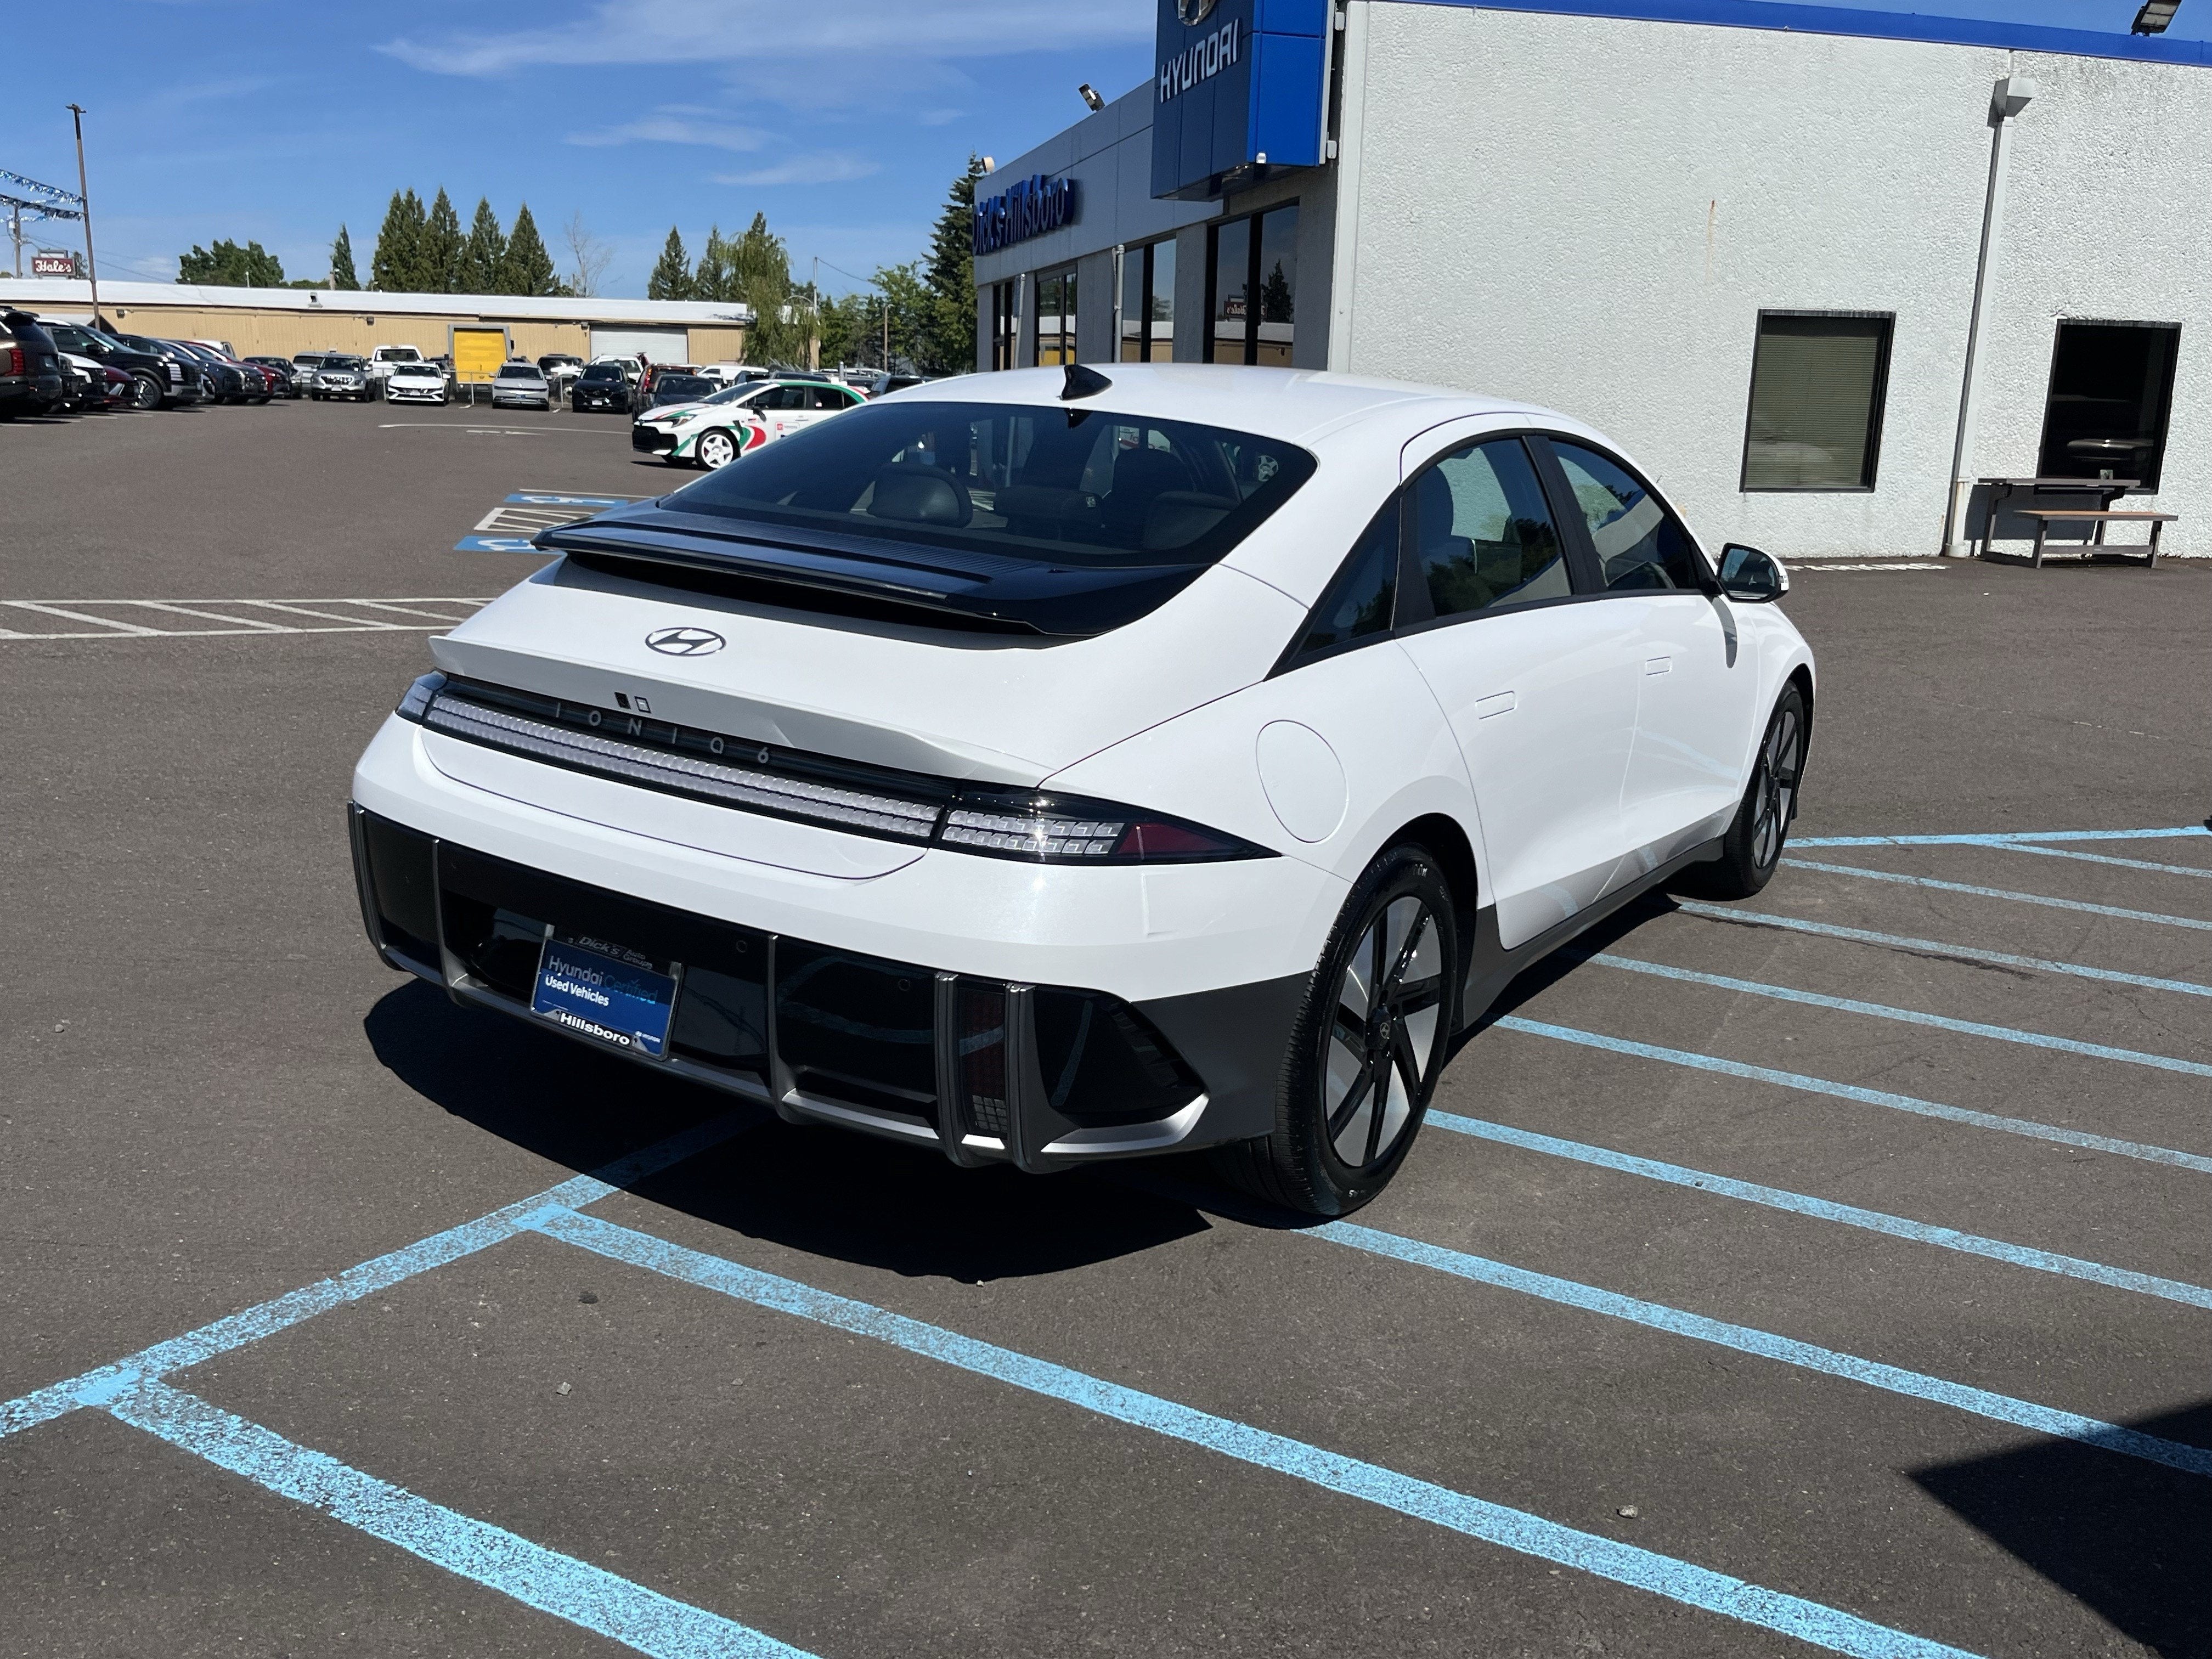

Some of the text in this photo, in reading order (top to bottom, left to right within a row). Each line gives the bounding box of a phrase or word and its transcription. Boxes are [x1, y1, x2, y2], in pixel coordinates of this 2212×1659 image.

[1160, 18, 1239, 104] HYUNDAI
[1005, 175, 1069, 245] Hillsboro
[35, 260, 72, 273] Hale's
[556, 702, 769, 764] IONIQ 6
[578, 936, 620, 955] Dick's
[549, 956, 603, 986] Hyundai
[545, 974, 568, 992] Used
[570, 982, 609, 1006] Vehicles
[560, 1013, 630, 1045] Hillsboro
